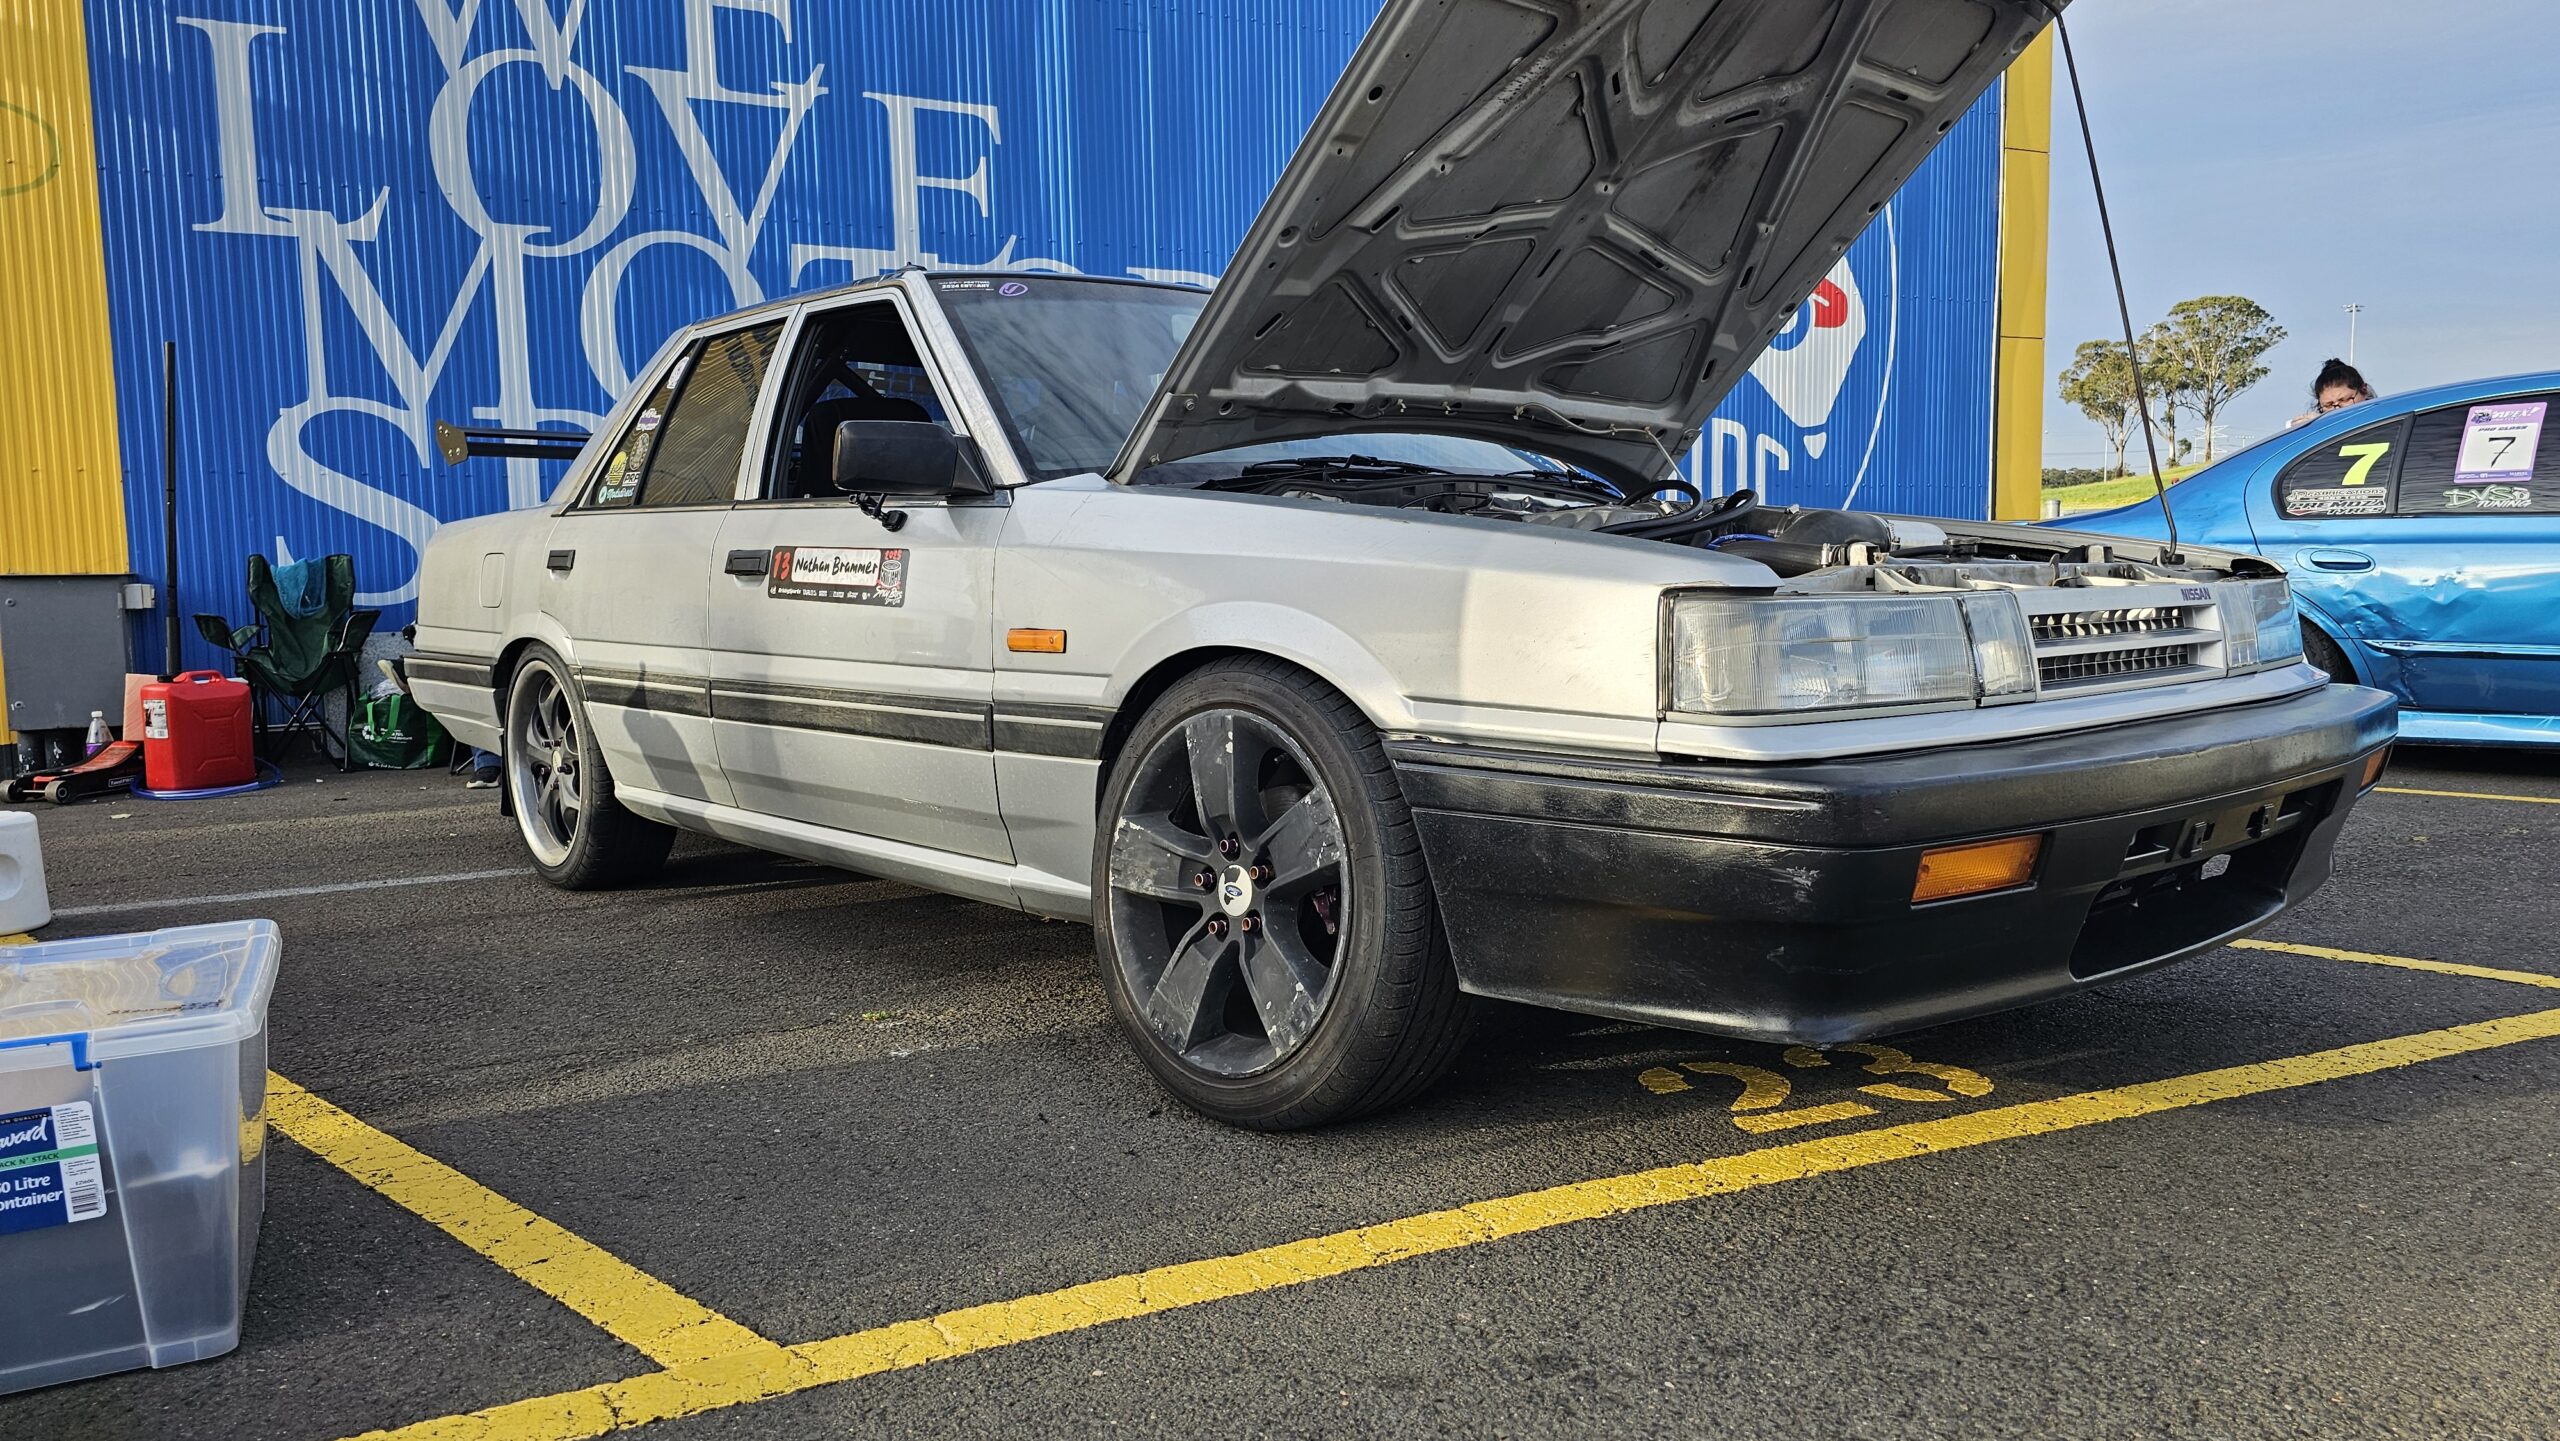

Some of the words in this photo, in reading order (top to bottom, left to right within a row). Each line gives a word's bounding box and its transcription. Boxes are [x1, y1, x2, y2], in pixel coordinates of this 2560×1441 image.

[177, 16, 1016, 272] LOVE
[2488, 436, 2517, 468] 7
[2338, 442, 2390, 485] 7
[2327, 507, 2383, 515] TYRES
[2476, 499, 2532, 508] TUNING
[773, 551, 792, 580] 13
[794, 556, 830, 574] Nathan
[831, 556, 878, 576] Brammer
[2180, 586, 2212, 601] NISSAN
[1637, 1043, 1995, 1134] 23
[32, 1152, 60, 1163] STACK
[15, 1175, 52, 1192] Litre
